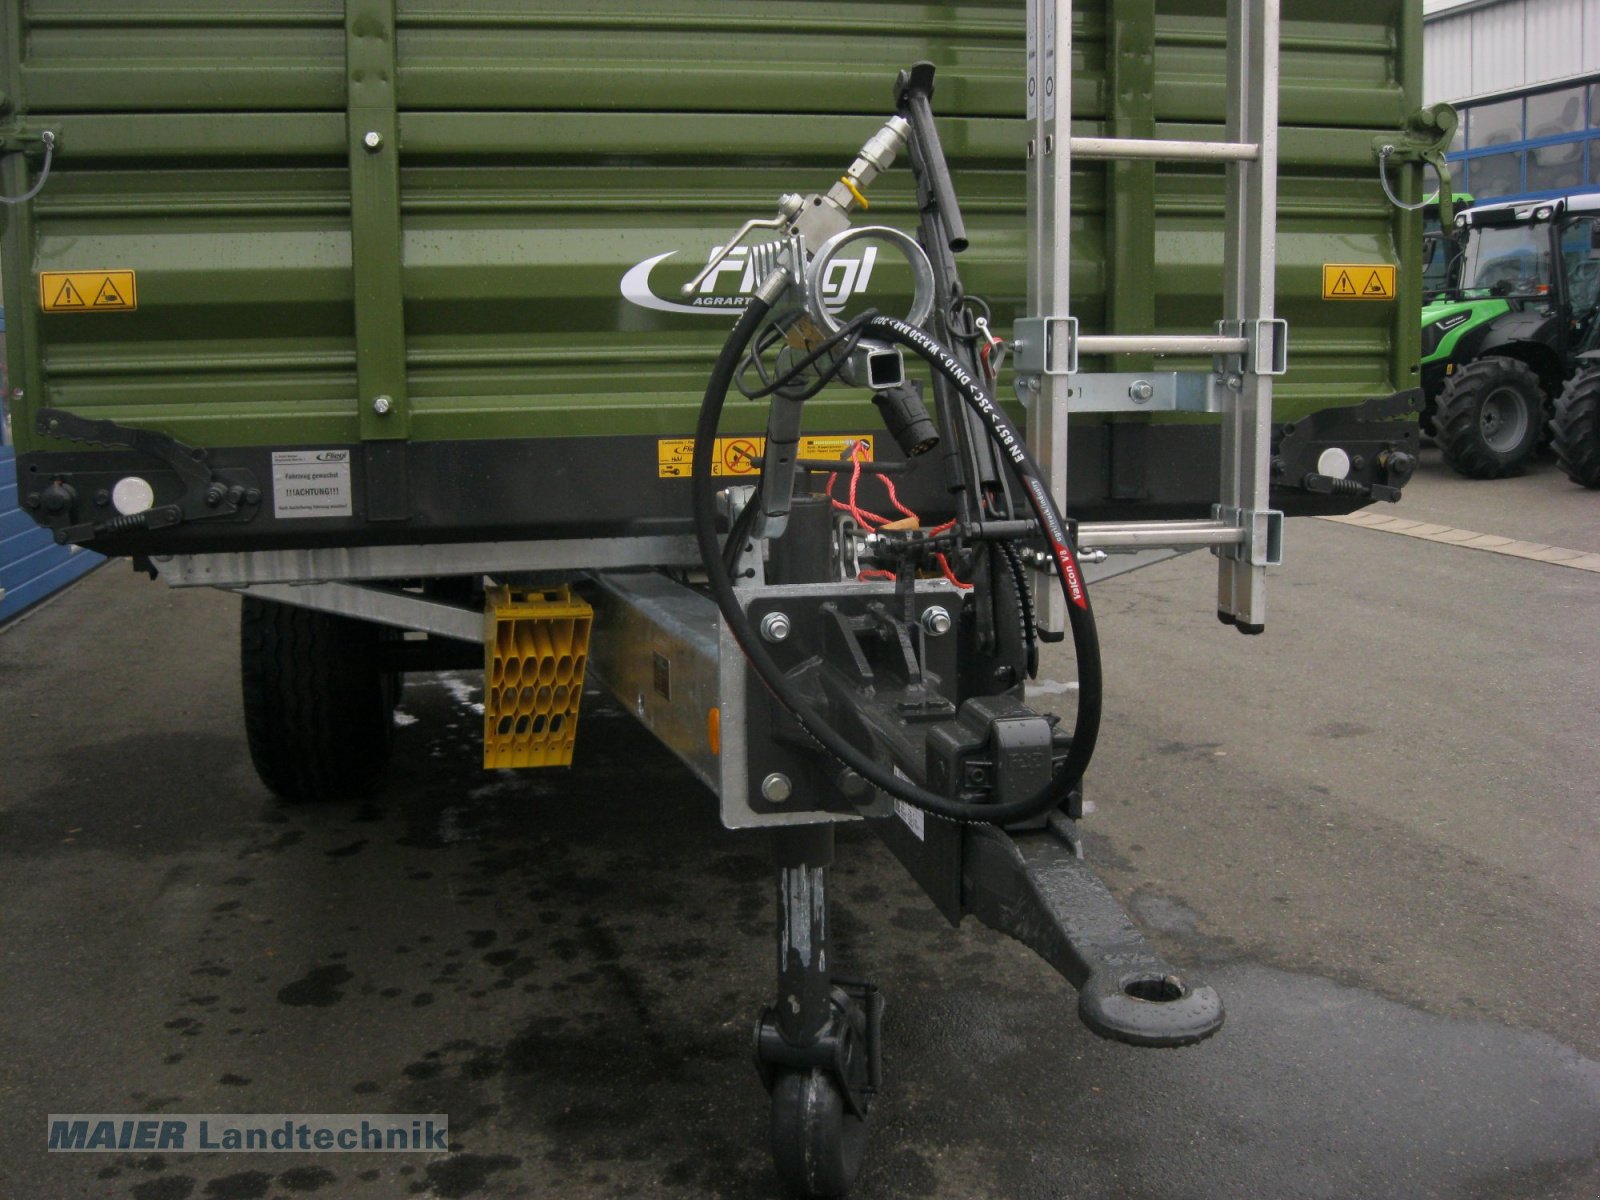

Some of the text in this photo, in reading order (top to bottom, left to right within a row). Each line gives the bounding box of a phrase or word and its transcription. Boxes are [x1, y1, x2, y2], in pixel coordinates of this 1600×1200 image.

[893, 320, 912, 335] BAR
[944, 359, 971, 386] DN10
[974, 392, 994, 413] 2SC
[995, 424, 1014, 446] 857
[1009, 444, 1025, 464] EN
[285, 473, 311, 481] Fahrzeug
[286, 487, 339, 497] !!!ACHTUNG!!!
